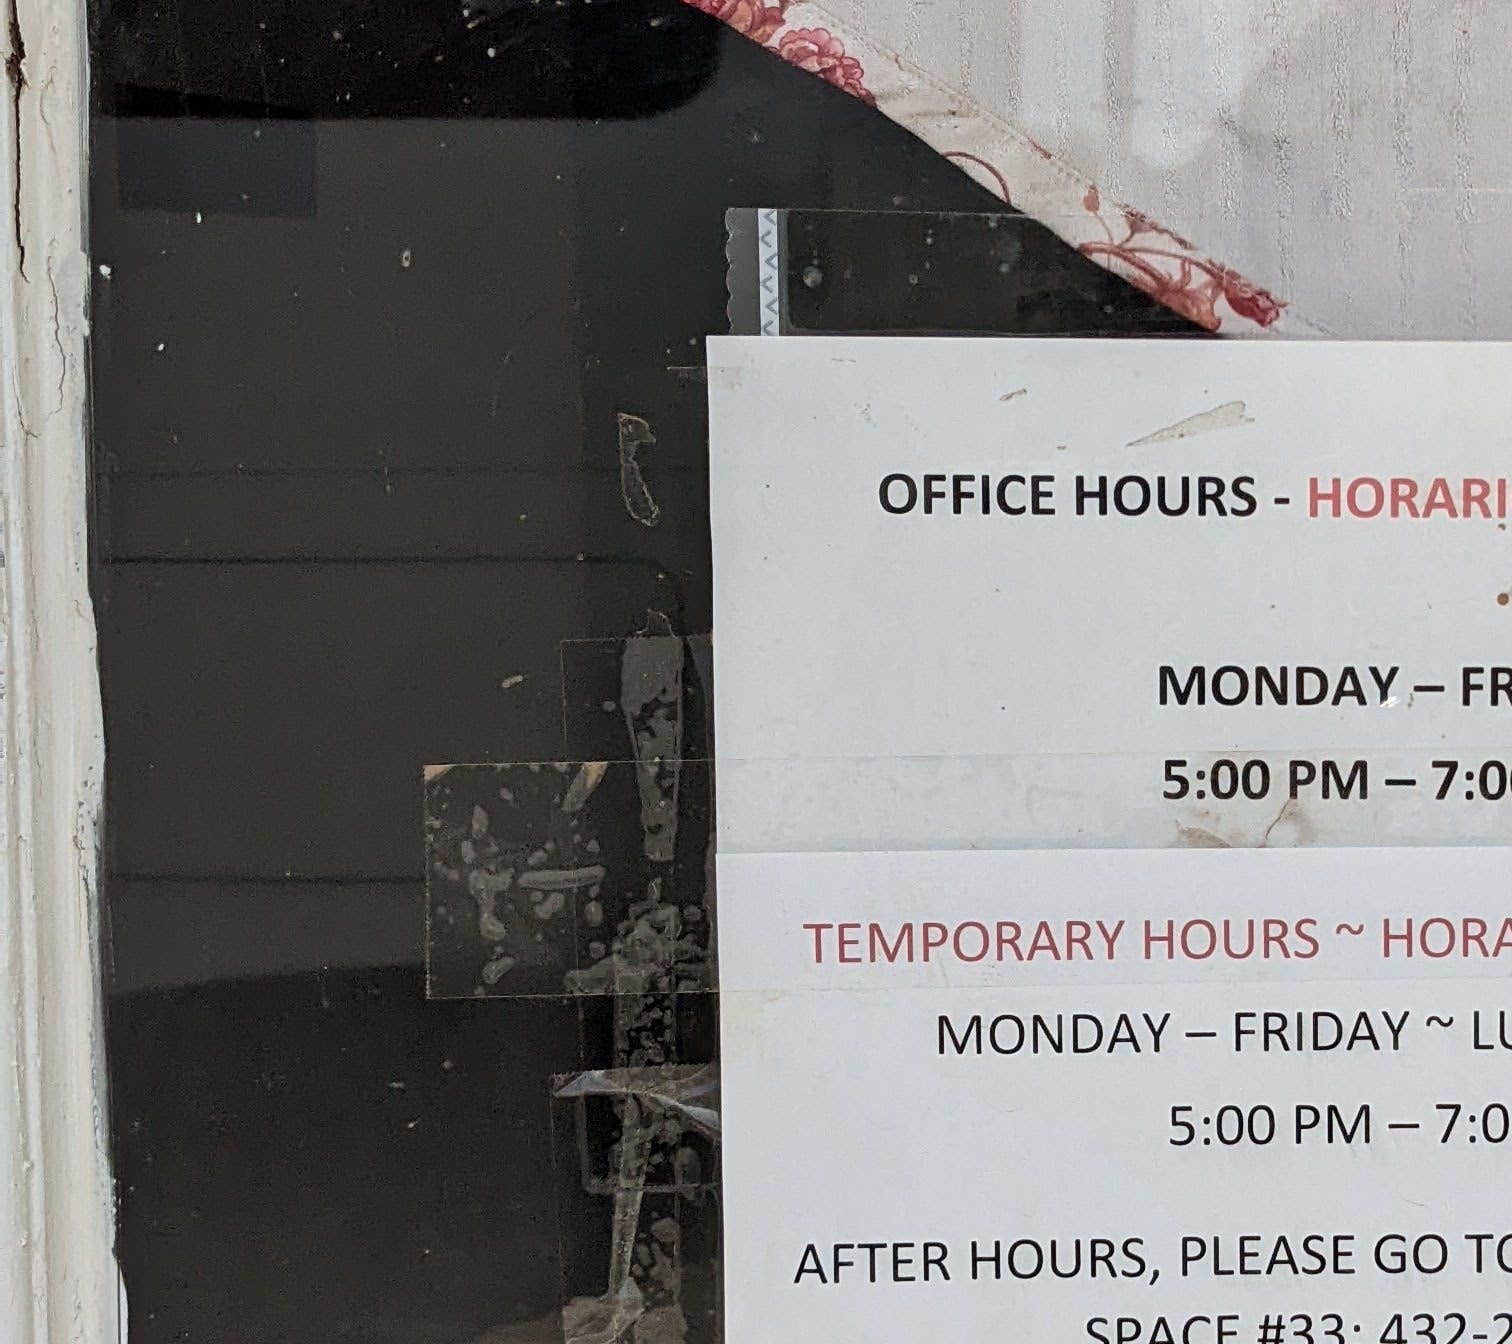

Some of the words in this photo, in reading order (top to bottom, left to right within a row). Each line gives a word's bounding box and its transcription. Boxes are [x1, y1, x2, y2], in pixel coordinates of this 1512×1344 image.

[878, 472, 1056, 516] OFFICE
[1075, 474, 1258, 518] HOURS
[1158, 664, 1400, 707] MONDAY
[1162, 758, 1271, 801] 5:00
[1287, 759, 1370, 803] PM
[802, 919, 1126, 964] TEMPORARY
[1144, 918, 1320, 960] HOURS
[937, 1012, 1171, 1055] MONDAY
[1234, 1010, 1410, 1053] FRIDAY
[1169, 1104, 1276, 1147] 5:00
[1295, 1103, 1371, 1145] PM
[793, 1241, 951, 1285] AFTER
[970, 1237, 1160, 1287] HOURS,
[1181, 1234, 1356, 1277] PLEASE
[1373, 1233, 1449, 1275] GO
